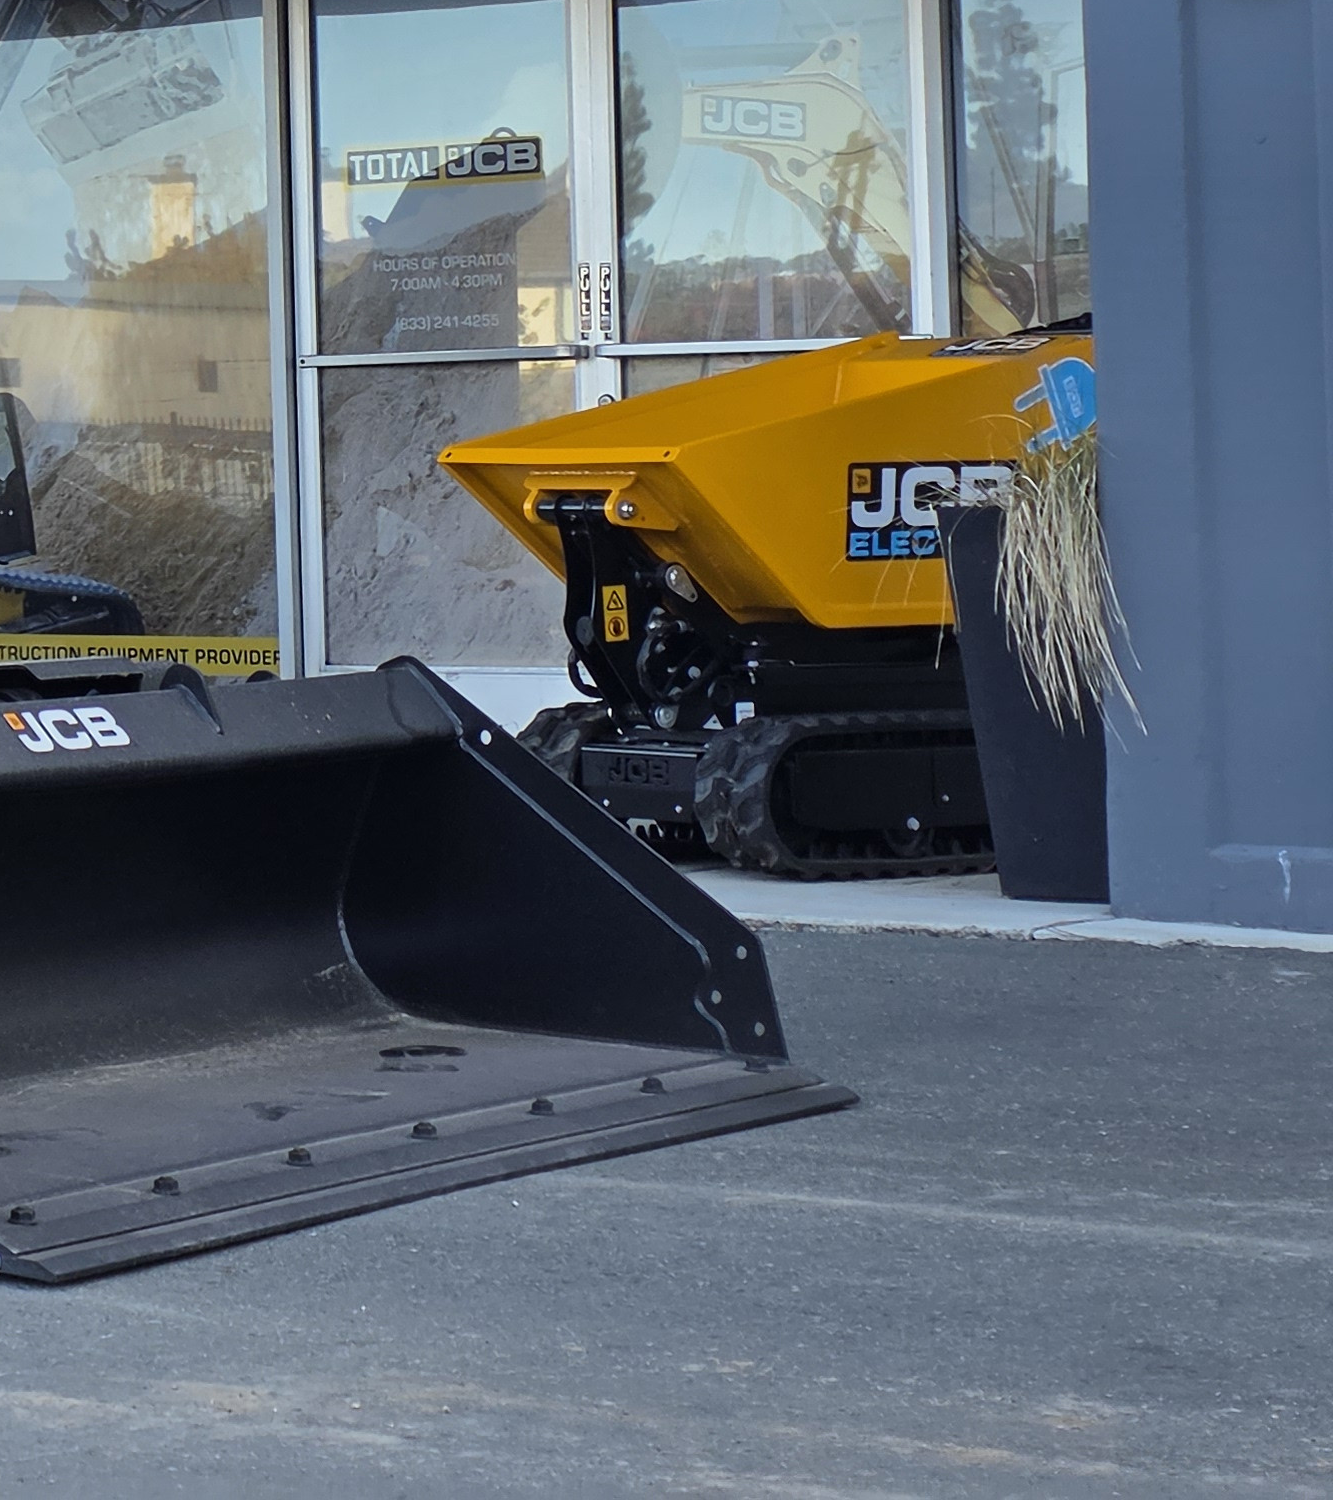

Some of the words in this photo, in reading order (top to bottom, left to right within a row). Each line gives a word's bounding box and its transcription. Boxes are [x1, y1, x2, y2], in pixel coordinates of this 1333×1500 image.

[703, 99, 804, 138] JCB
[350, 151, 437, 181] TOTAL
[447, 142, 538, 176] JCB
[374, 258, 419, 272] HOURS
[421, 257, 439, 270] OF
[441, 253, 516, 269] OPERATION
[579, 267, 590, 315] PULL
[600, 267, 610, 315] PULL
[395, 315, 431, 331] (833)
[849, 530, 940, 557] ELEC
[18, 707, 130, 753] JCB
